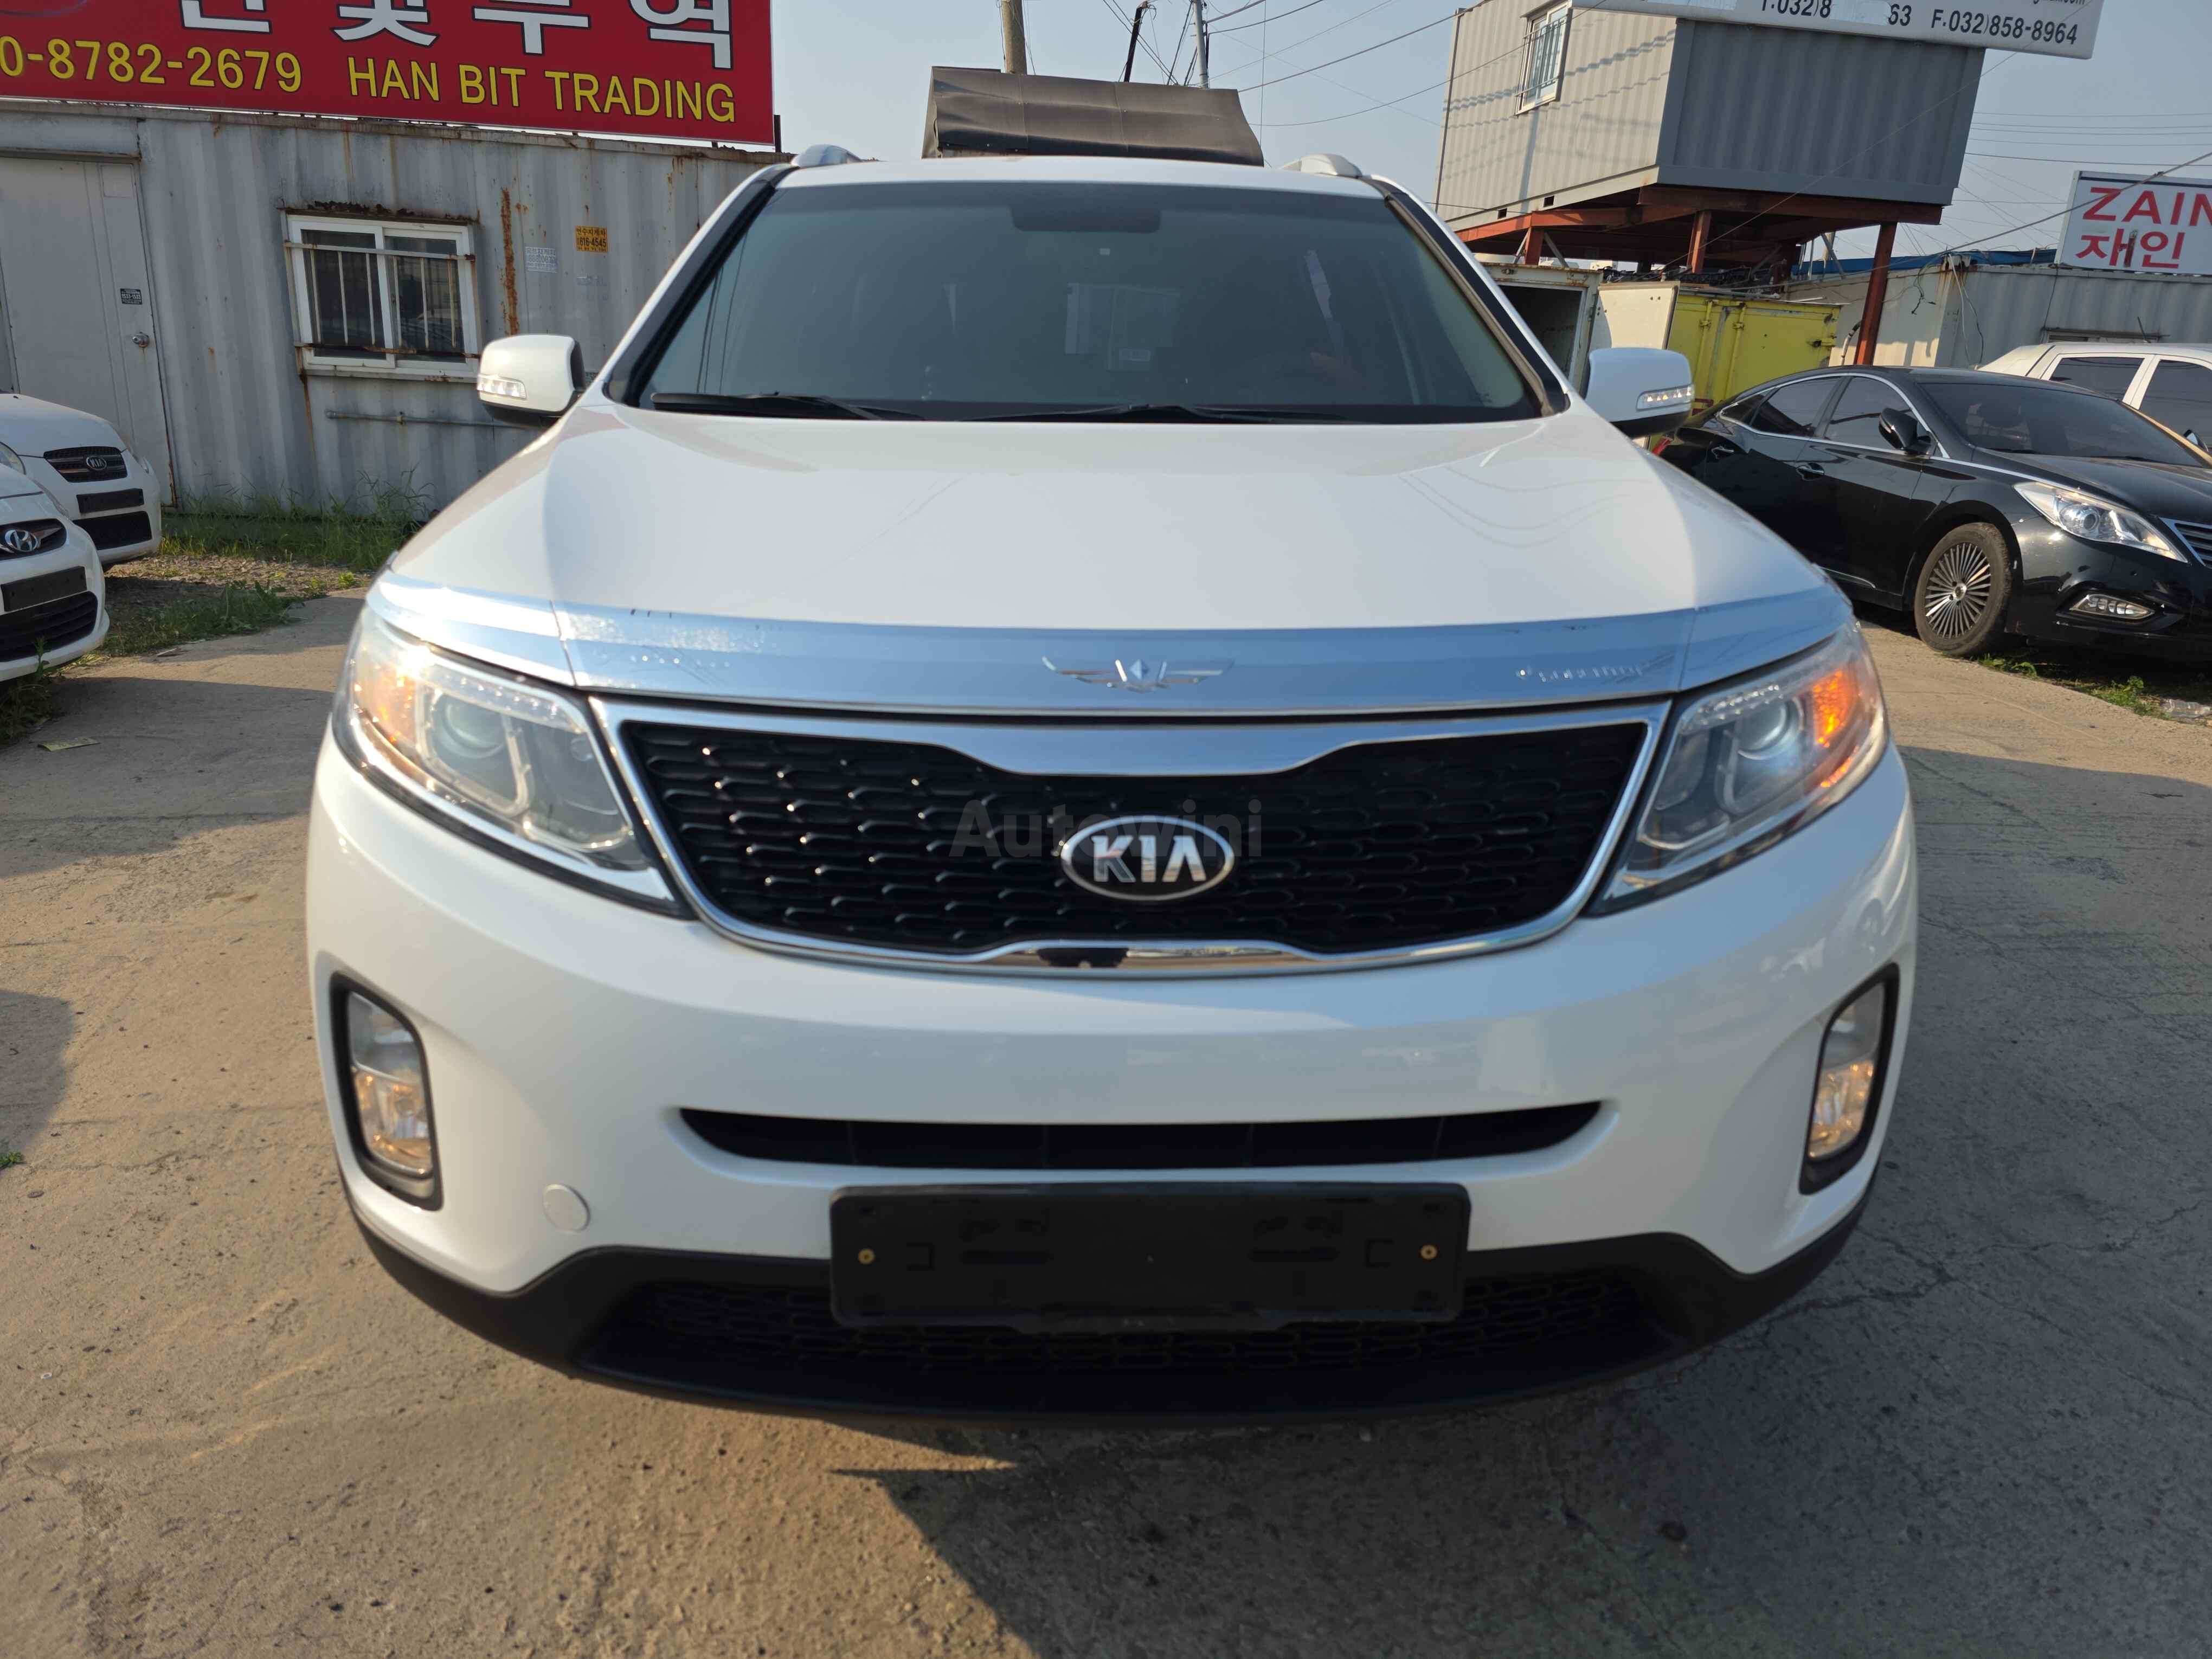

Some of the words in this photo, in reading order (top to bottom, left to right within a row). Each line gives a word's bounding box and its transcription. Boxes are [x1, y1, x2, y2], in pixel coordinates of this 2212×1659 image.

[1931, 9, 2078, 44] F.032)858-8964
[0, 36, 301, 92] 0-8782-2679
[348, 56, 440, 101] HAN
[459, 64, 526, 107] BIT
[544, 70, 735, 123] TRADING
[2075, 228, 2186, 269] 재인
[1091, 835, 1207, 883] KIA
